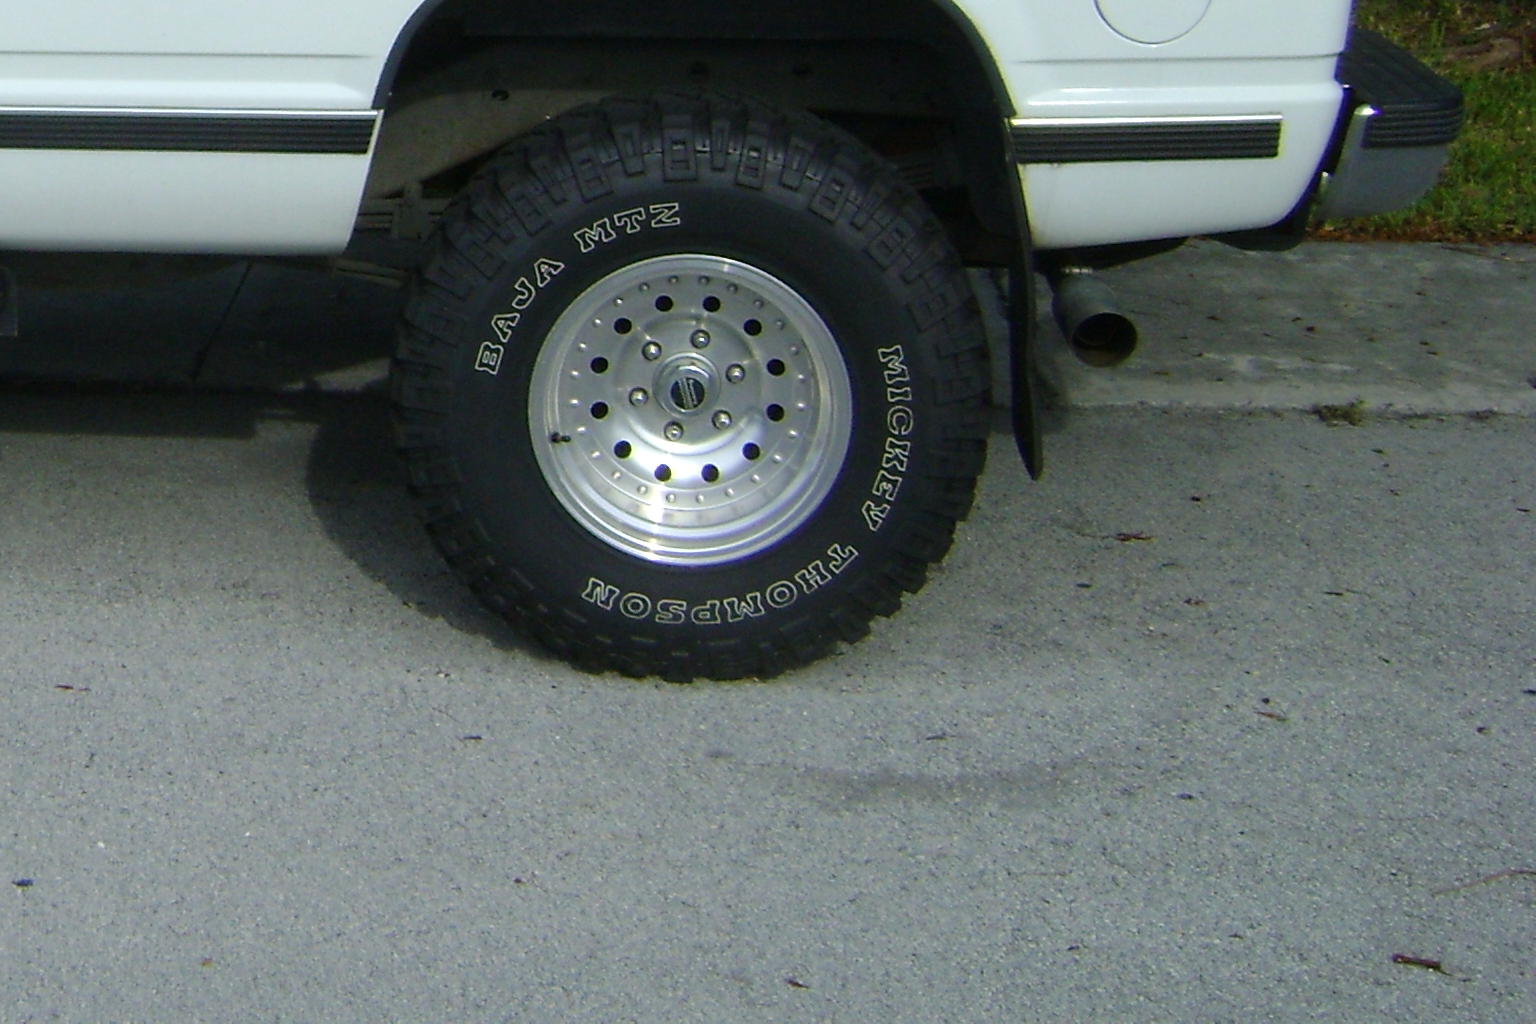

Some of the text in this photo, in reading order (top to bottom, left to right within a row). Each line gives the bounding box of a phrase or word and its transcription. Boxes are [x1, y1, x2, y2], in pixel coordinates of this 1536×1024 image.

[475, 202, 681, 375] BAJA MTZ
[582, 345, 914, 624] MICKEY THOMPSON
